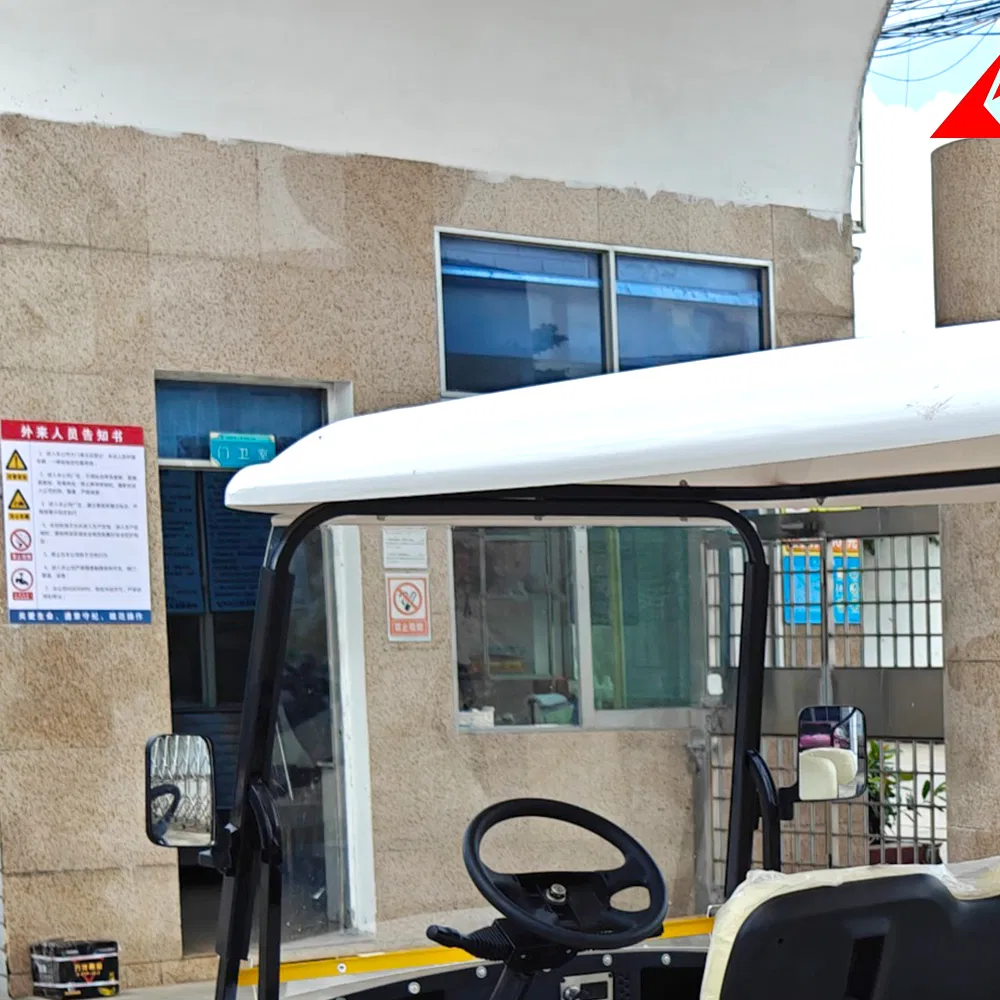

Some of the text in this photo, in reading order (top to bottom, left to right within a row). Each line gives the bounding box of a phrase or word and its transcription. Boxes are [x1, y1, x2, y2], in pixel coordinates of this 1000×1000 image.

[20, 424, 124, 443] 外来人员告知书
